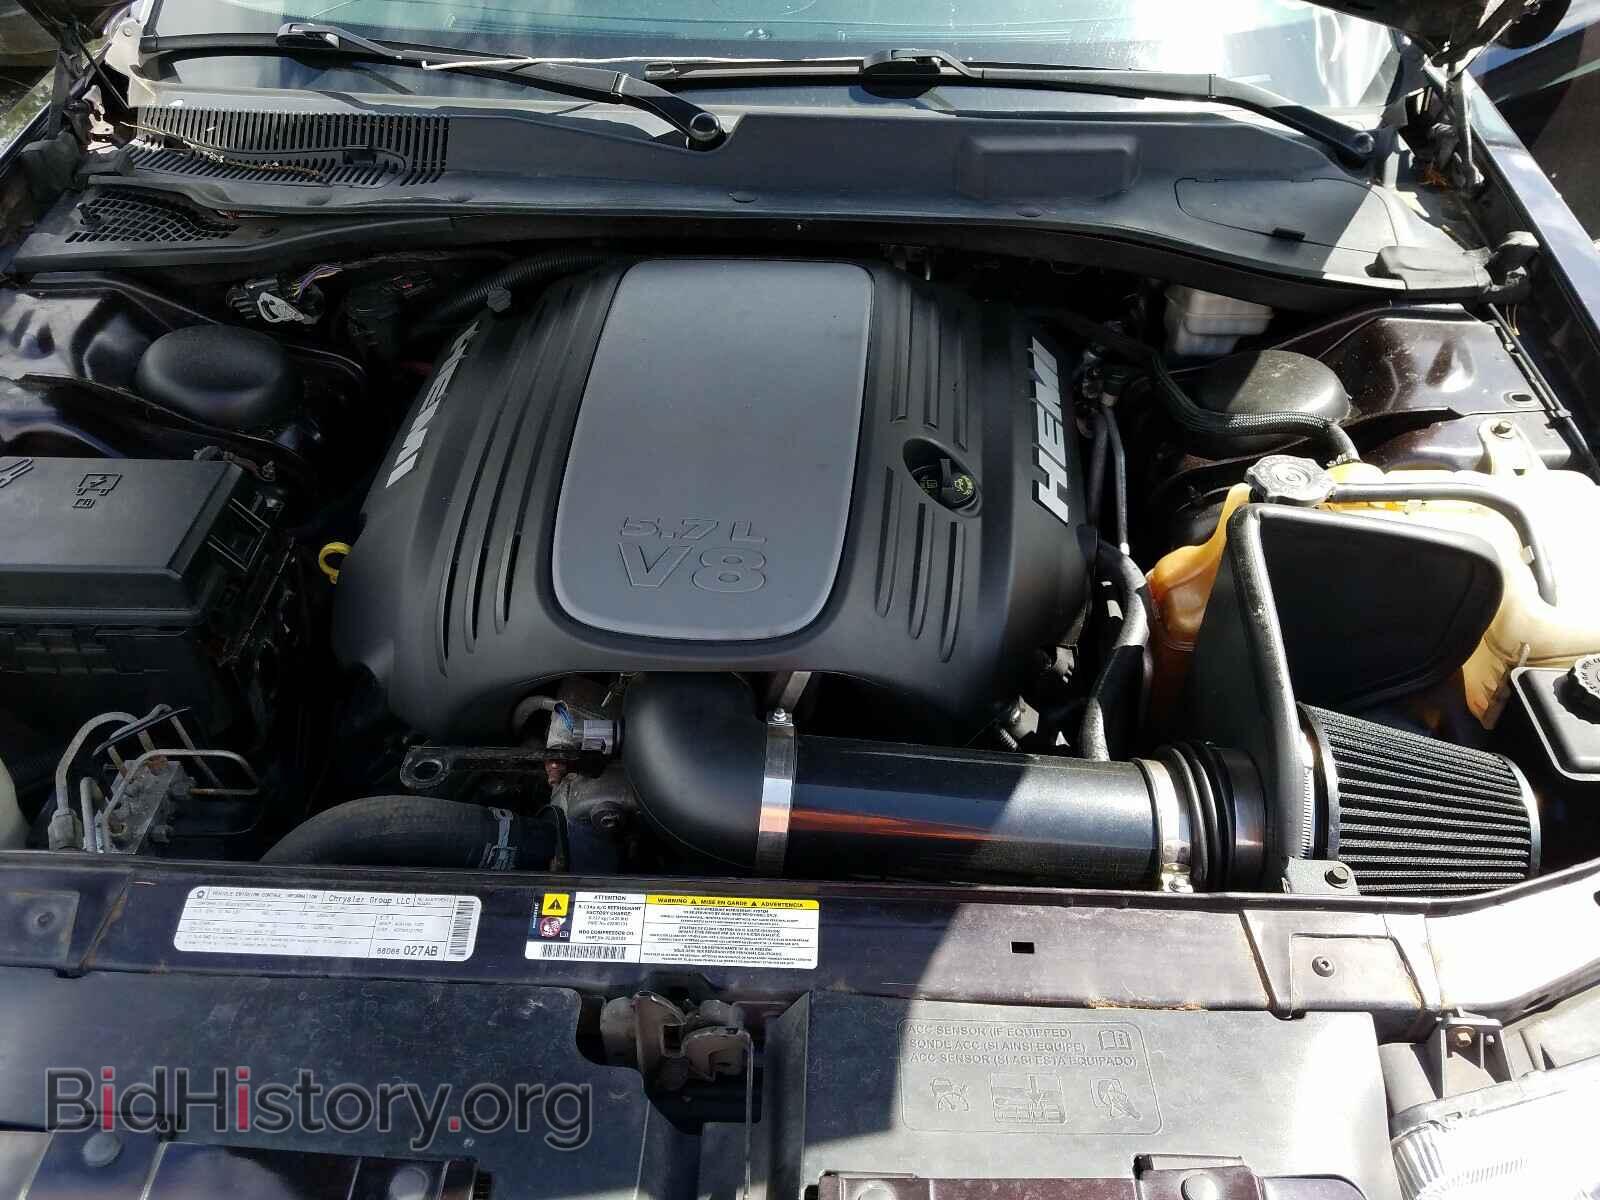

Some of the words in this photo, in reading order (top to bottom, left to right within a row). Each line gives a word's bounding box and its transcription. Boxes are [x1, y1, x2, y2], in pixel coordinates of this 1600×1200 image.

[385, 320, 480, 489] HEMI
[1029, 336, 1069, 524] HEMI
[620, 517, 719, 540] 5.7
[729, 520, 768, 545] L
[617, 542, 767, 593] V8
[328, 894, 365, 904] Chrysler
[369, 896, 392, 905] Group
[657, 896, 688, 904] WARNING
[403, 946, 438, 957] 027AB
[909, 1024, 934, 1034] ACC
[936, 1025, 987, 1037] SENSOR
[1007, 1027, 1073, 1039] EQUIPPED)
[911, 1039, 952, 1050] SONDE
[954, 1040, 980, 1050] ACC
[911, 1052, 937, 1064] ACC
[940, 1053, 991, 1065] SENSOR
[1070, 1056, 1138, 1068] EQUIPADO)
